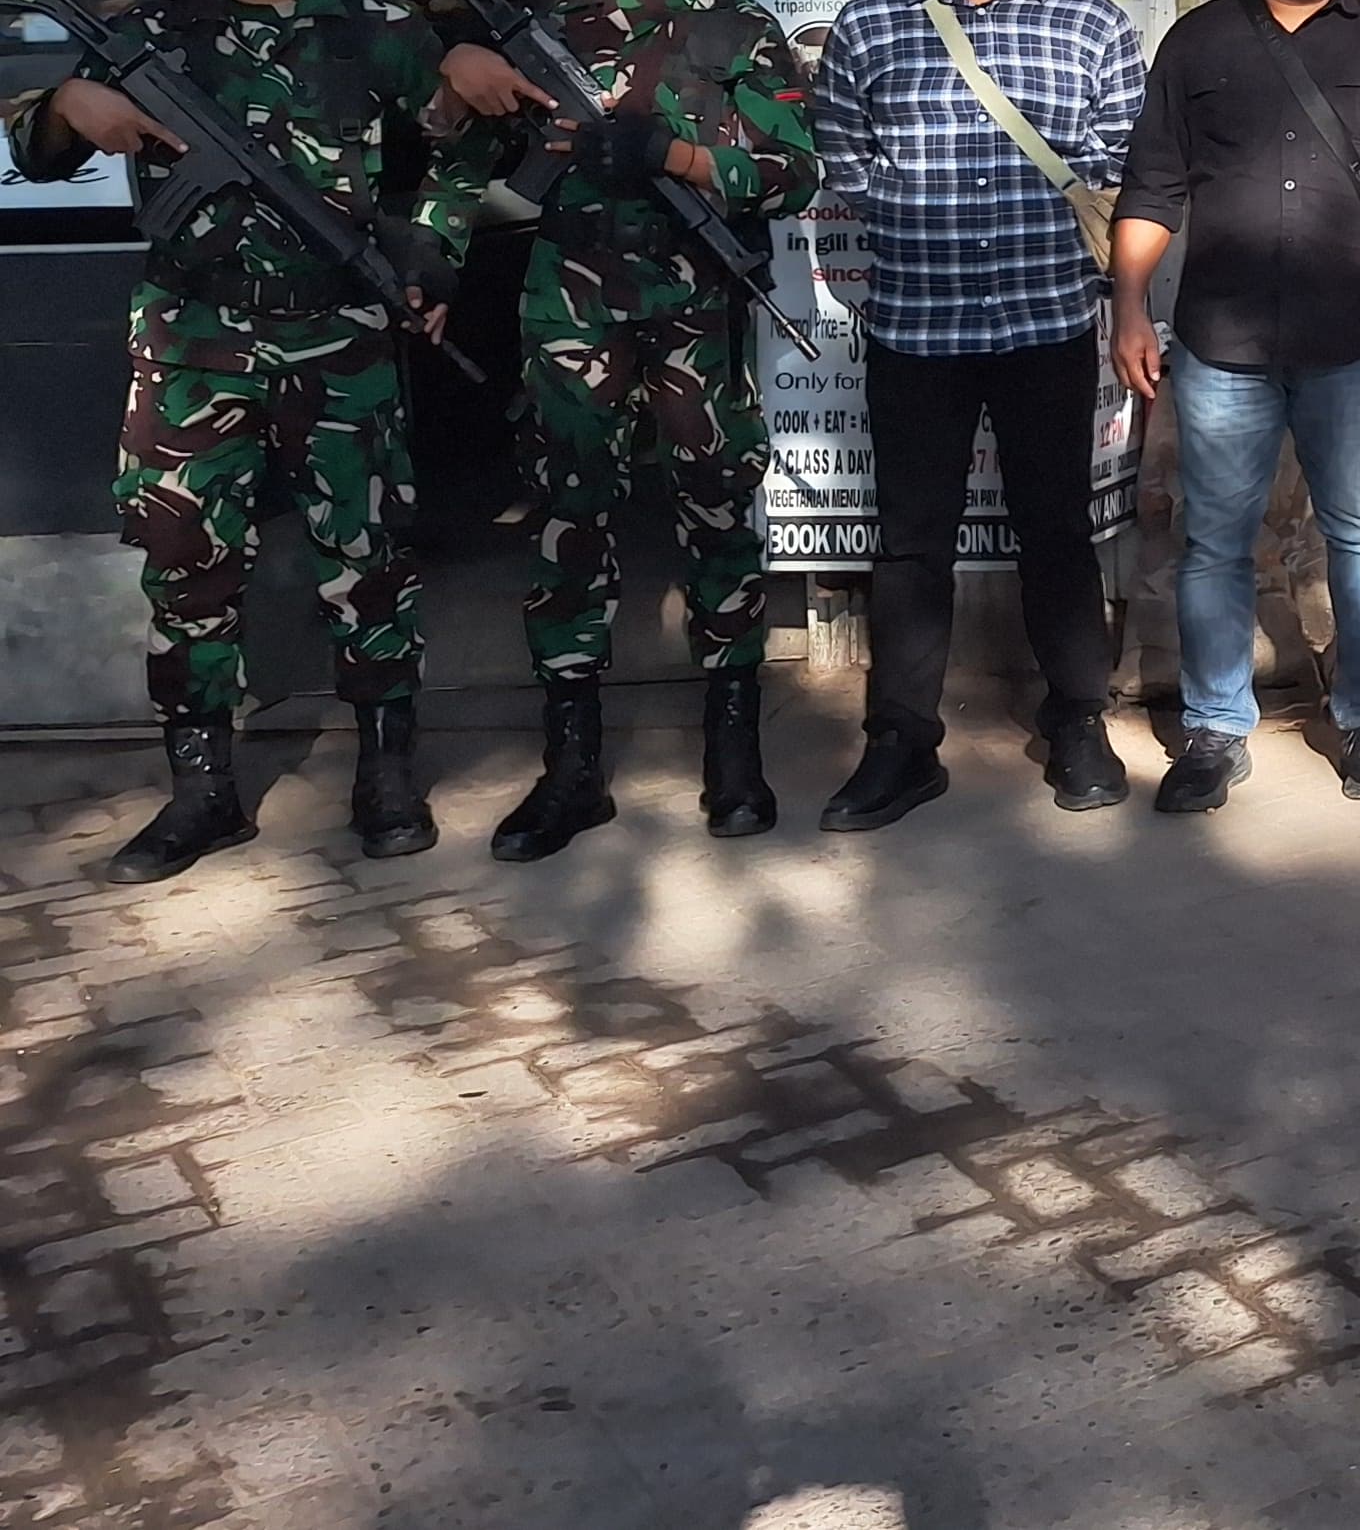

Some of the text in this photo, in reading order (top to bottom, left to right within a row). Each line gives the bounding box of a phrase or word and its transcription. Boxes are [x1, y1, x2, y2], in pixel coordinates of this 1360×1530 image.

[787, 233, 809, 251] in
[815, 309, 838, 339] Price
[775, 372, 864, 394] Only for
[774, 410, 809, 435] COOK
[824, 410, 846, 434] EAT
[773, 449, 873, 475] 2 CLASS A DAY
[768, 488, 829, 508] VEGETARIAN
[832, 488, 860, 508] MENU
[768, 523, 831, 554] BOOK
[956, 524, 993, 554] OIN
